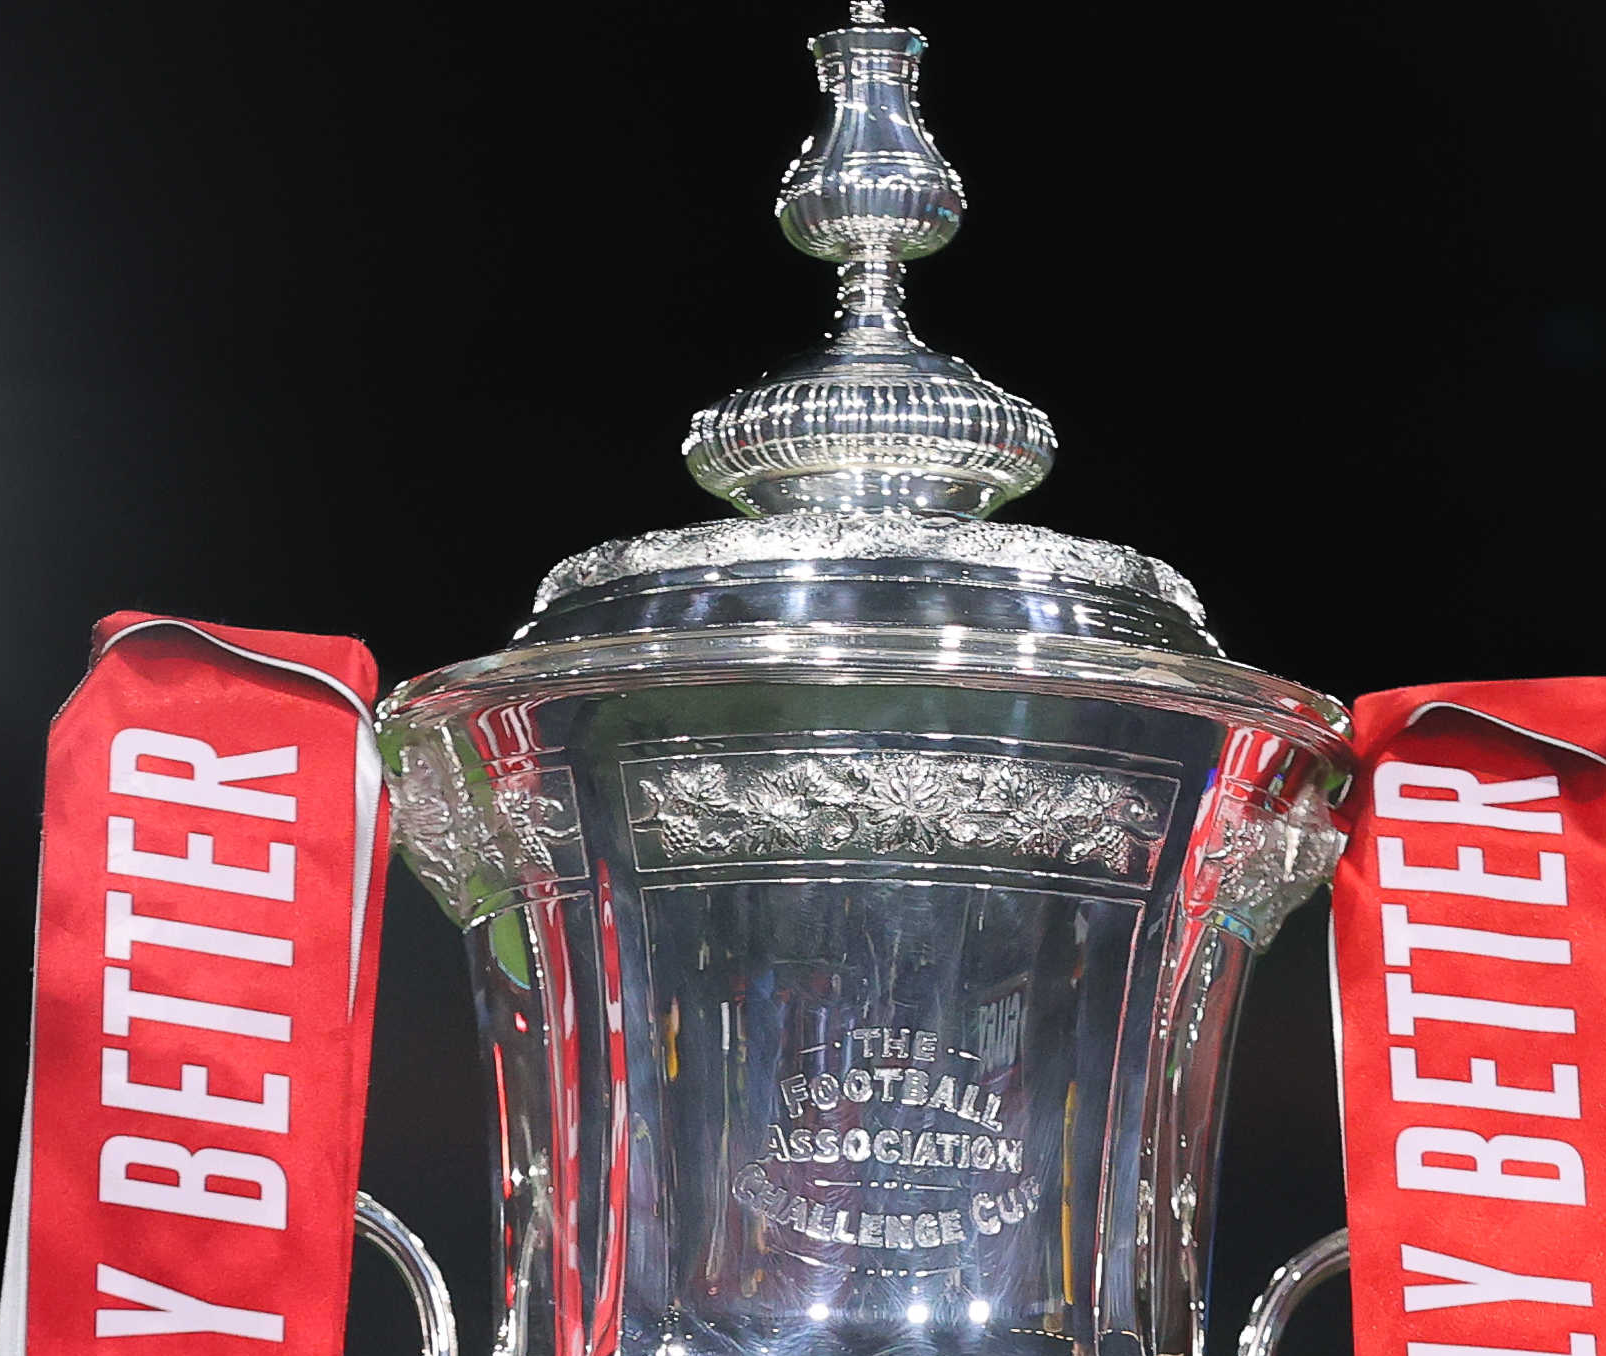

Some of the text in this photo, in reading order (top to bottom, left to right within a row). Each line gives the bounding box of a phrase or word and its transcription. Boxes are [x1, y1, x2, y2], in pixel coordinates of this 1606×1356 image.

[99, 727, 298, 1231] BETTER
[1373, 760, 1587, 1207] BETTER
[852, 1027, 938, 1062] THE
[780, 1067, 1003, 1132] FOOTBALL
[767, 1123, 1024, 1174] ASSOCIATION
[732, 1162, 1041, 1249] CHALLENGE CUP
